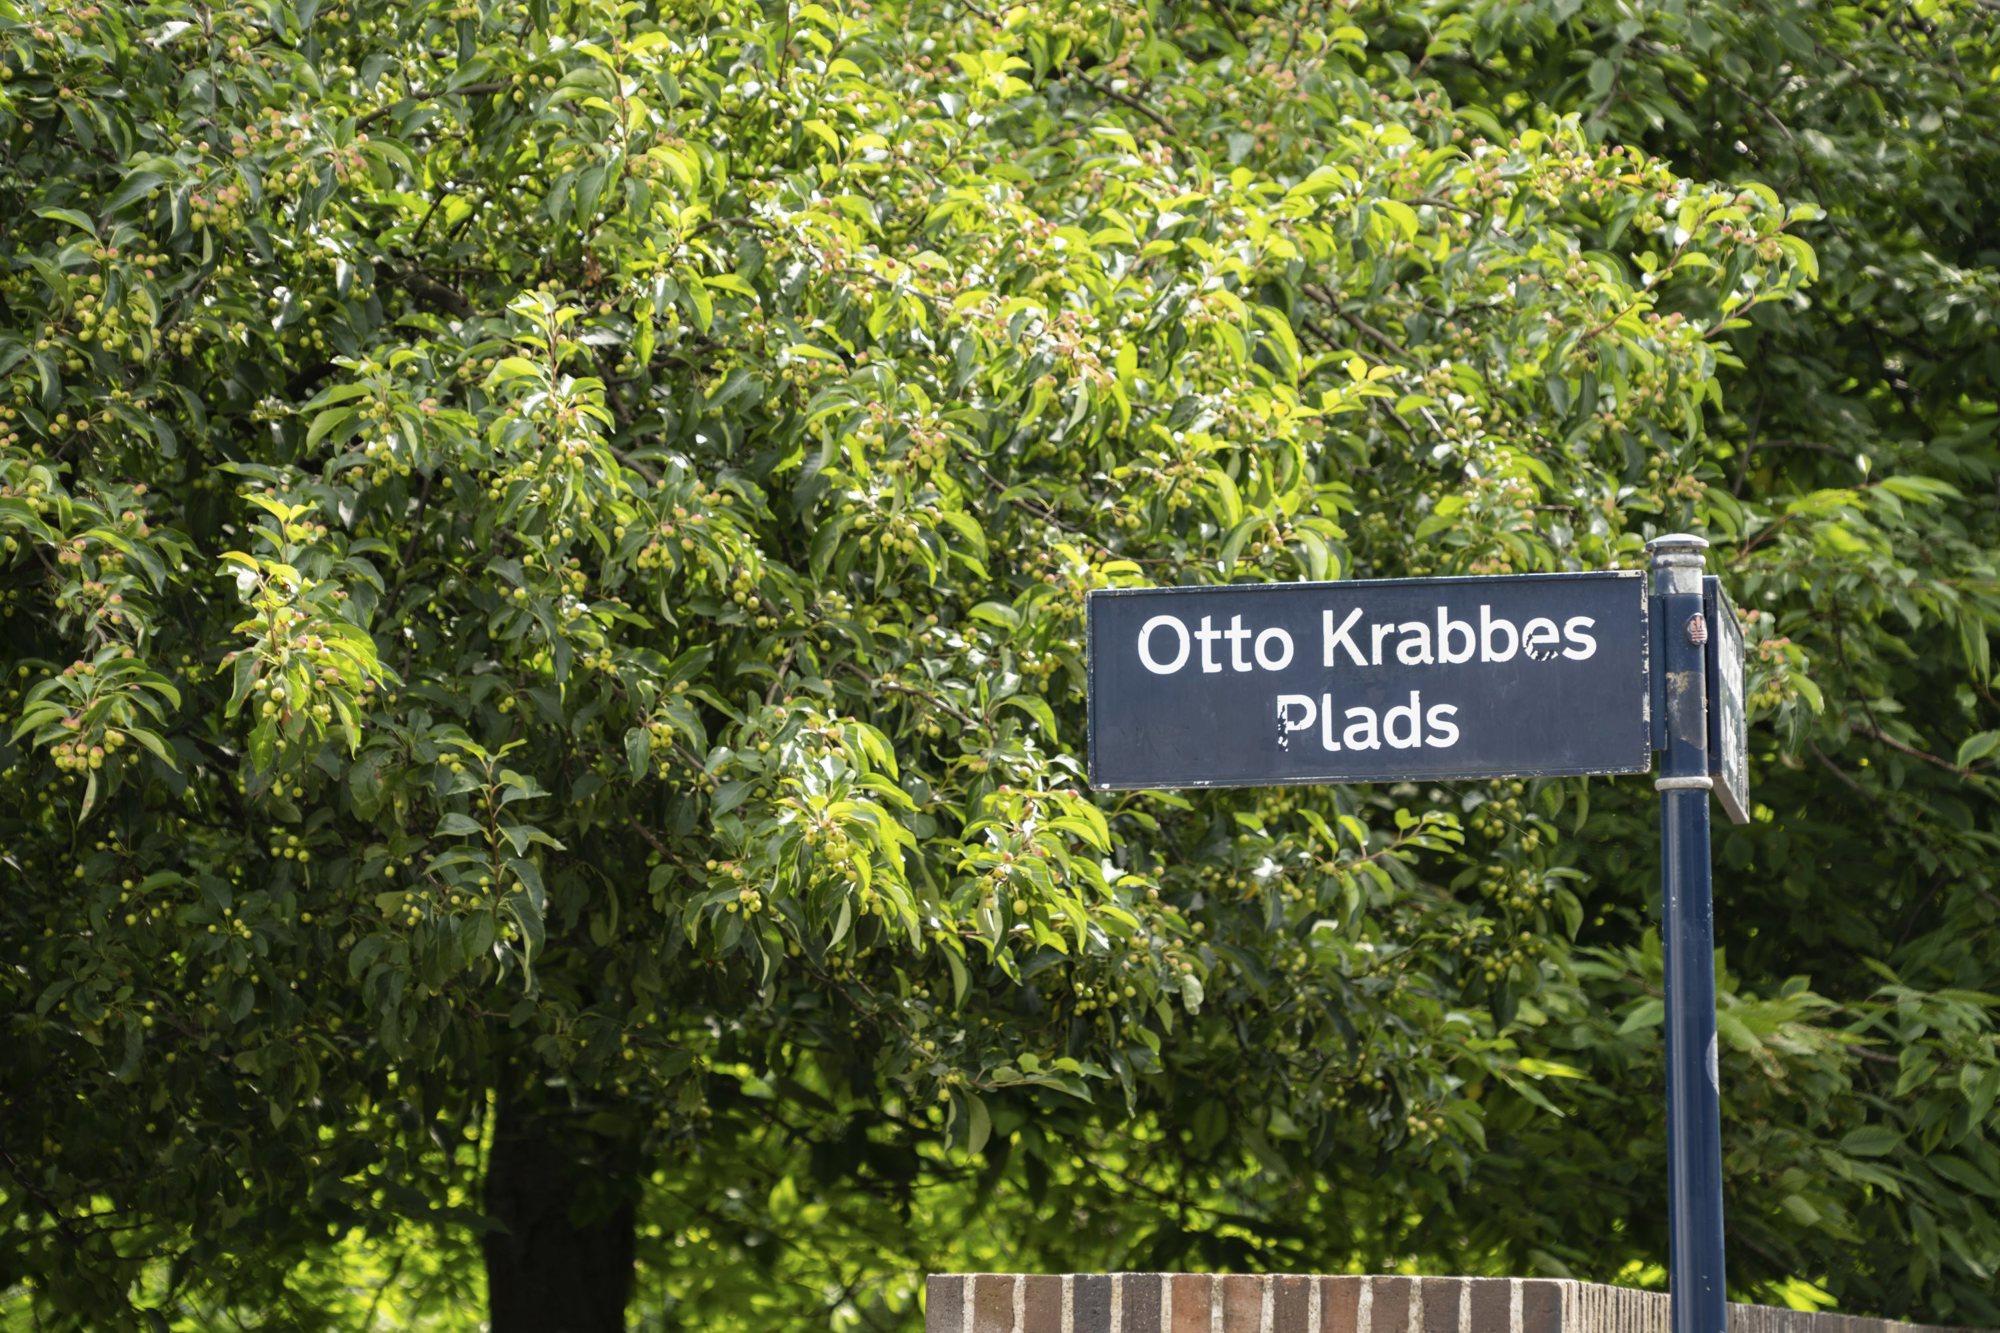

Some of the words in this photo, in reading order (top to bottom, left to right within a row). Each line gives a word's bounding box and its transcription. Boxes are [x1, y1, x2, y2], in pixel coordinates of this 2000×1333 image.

[1137, 614, 1295, 675] Otto
[1322, 604, 1598, 668] Krabbes
[1277, 689, 1460, 752] Plads
